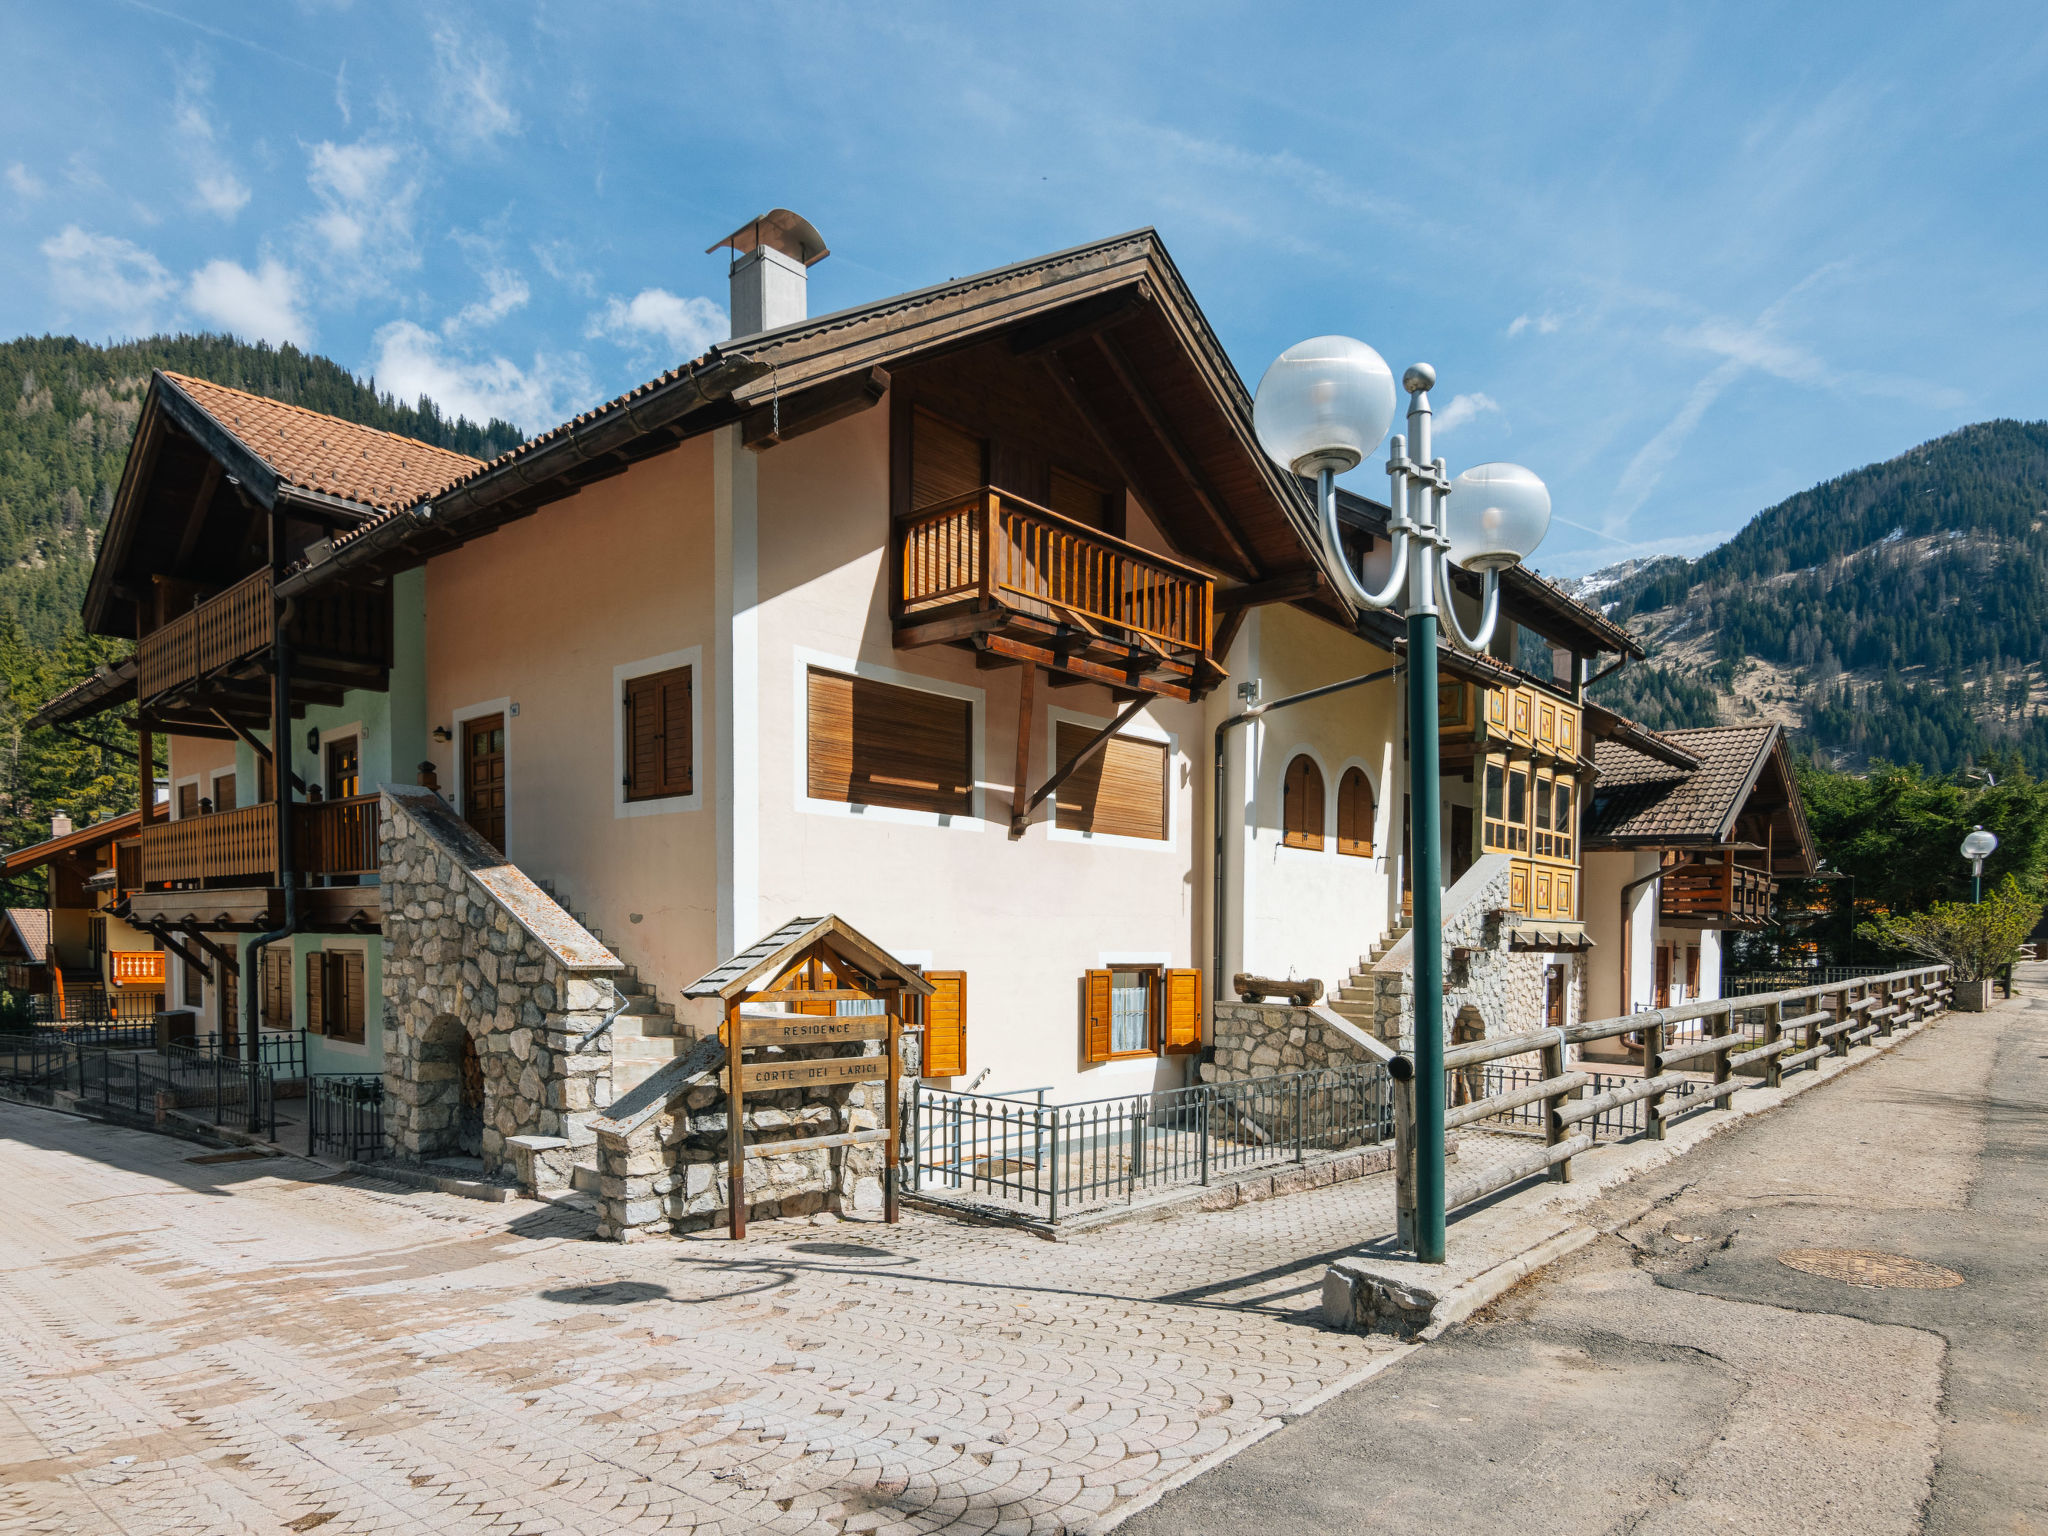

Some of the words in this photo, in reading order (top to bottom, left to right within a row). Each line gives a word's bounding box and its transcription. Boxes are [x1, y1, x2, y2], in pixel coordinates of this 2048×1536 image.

[784, 1023, 850, 1036] RESIDENCE
[756, 1069, 795, 1081] CORTE
[808, 1067, 827, 1078] DEI
[840, 1064, 877, 1076] LARICI
